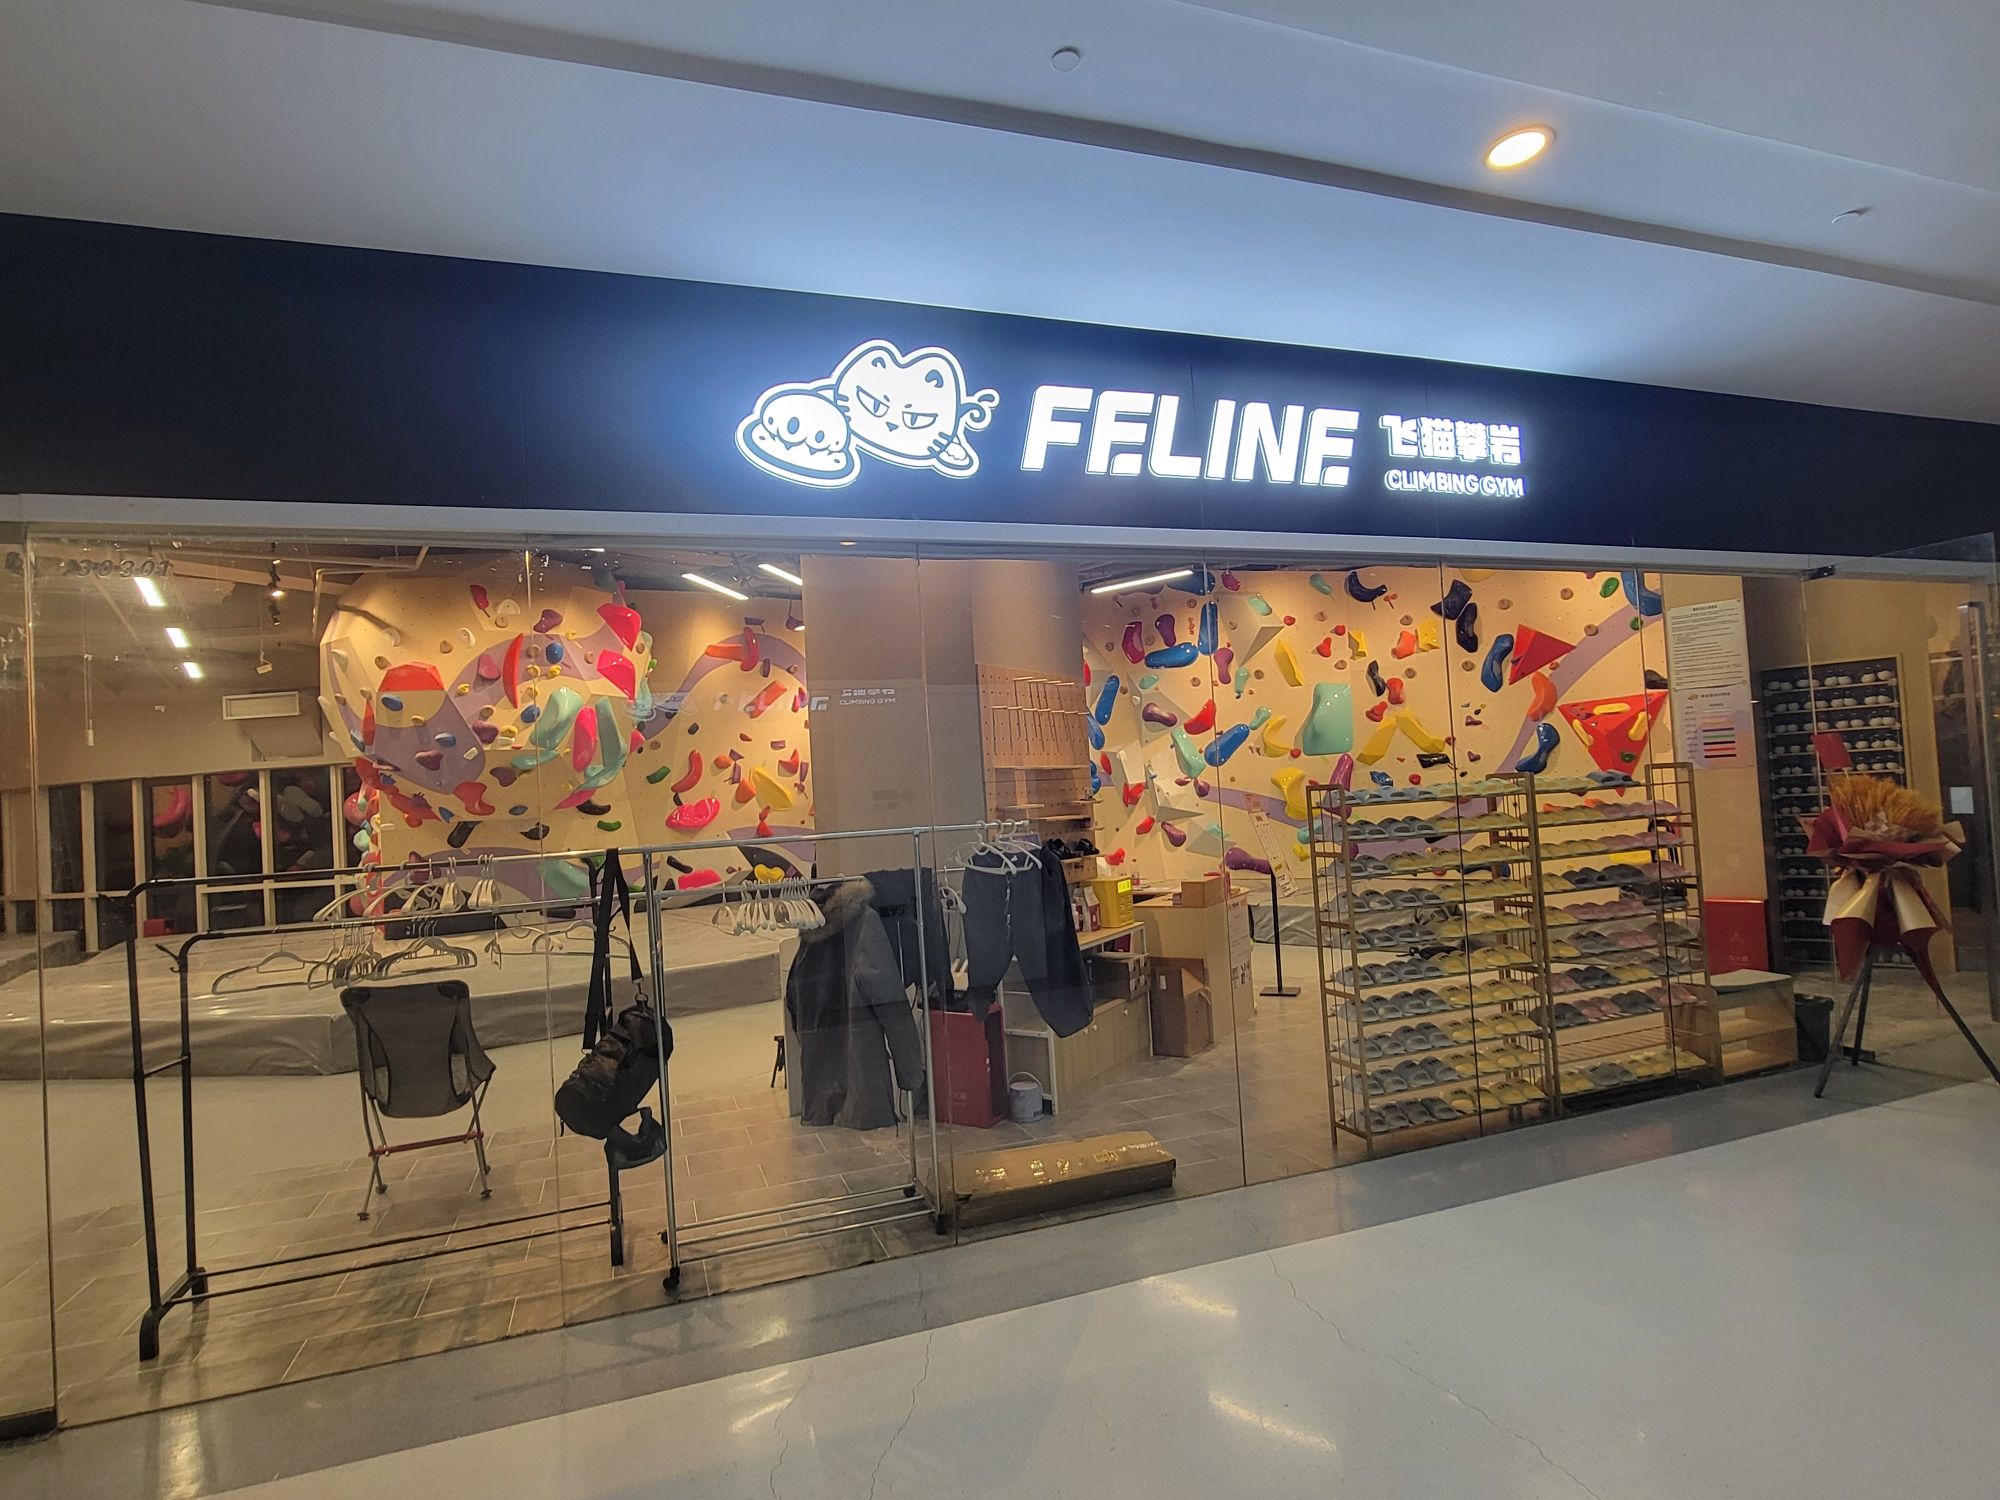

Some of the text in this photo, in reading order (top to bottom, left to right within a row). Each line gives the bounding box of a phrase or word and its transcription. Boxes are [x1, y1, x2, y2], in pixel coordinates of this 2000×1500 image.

[1020, 384, 1360, 488] FELINE
[1379, 414, 1522, 465] 飞猫攀岩
[1385, 469, 1525, 498] CLIMBING GYM
